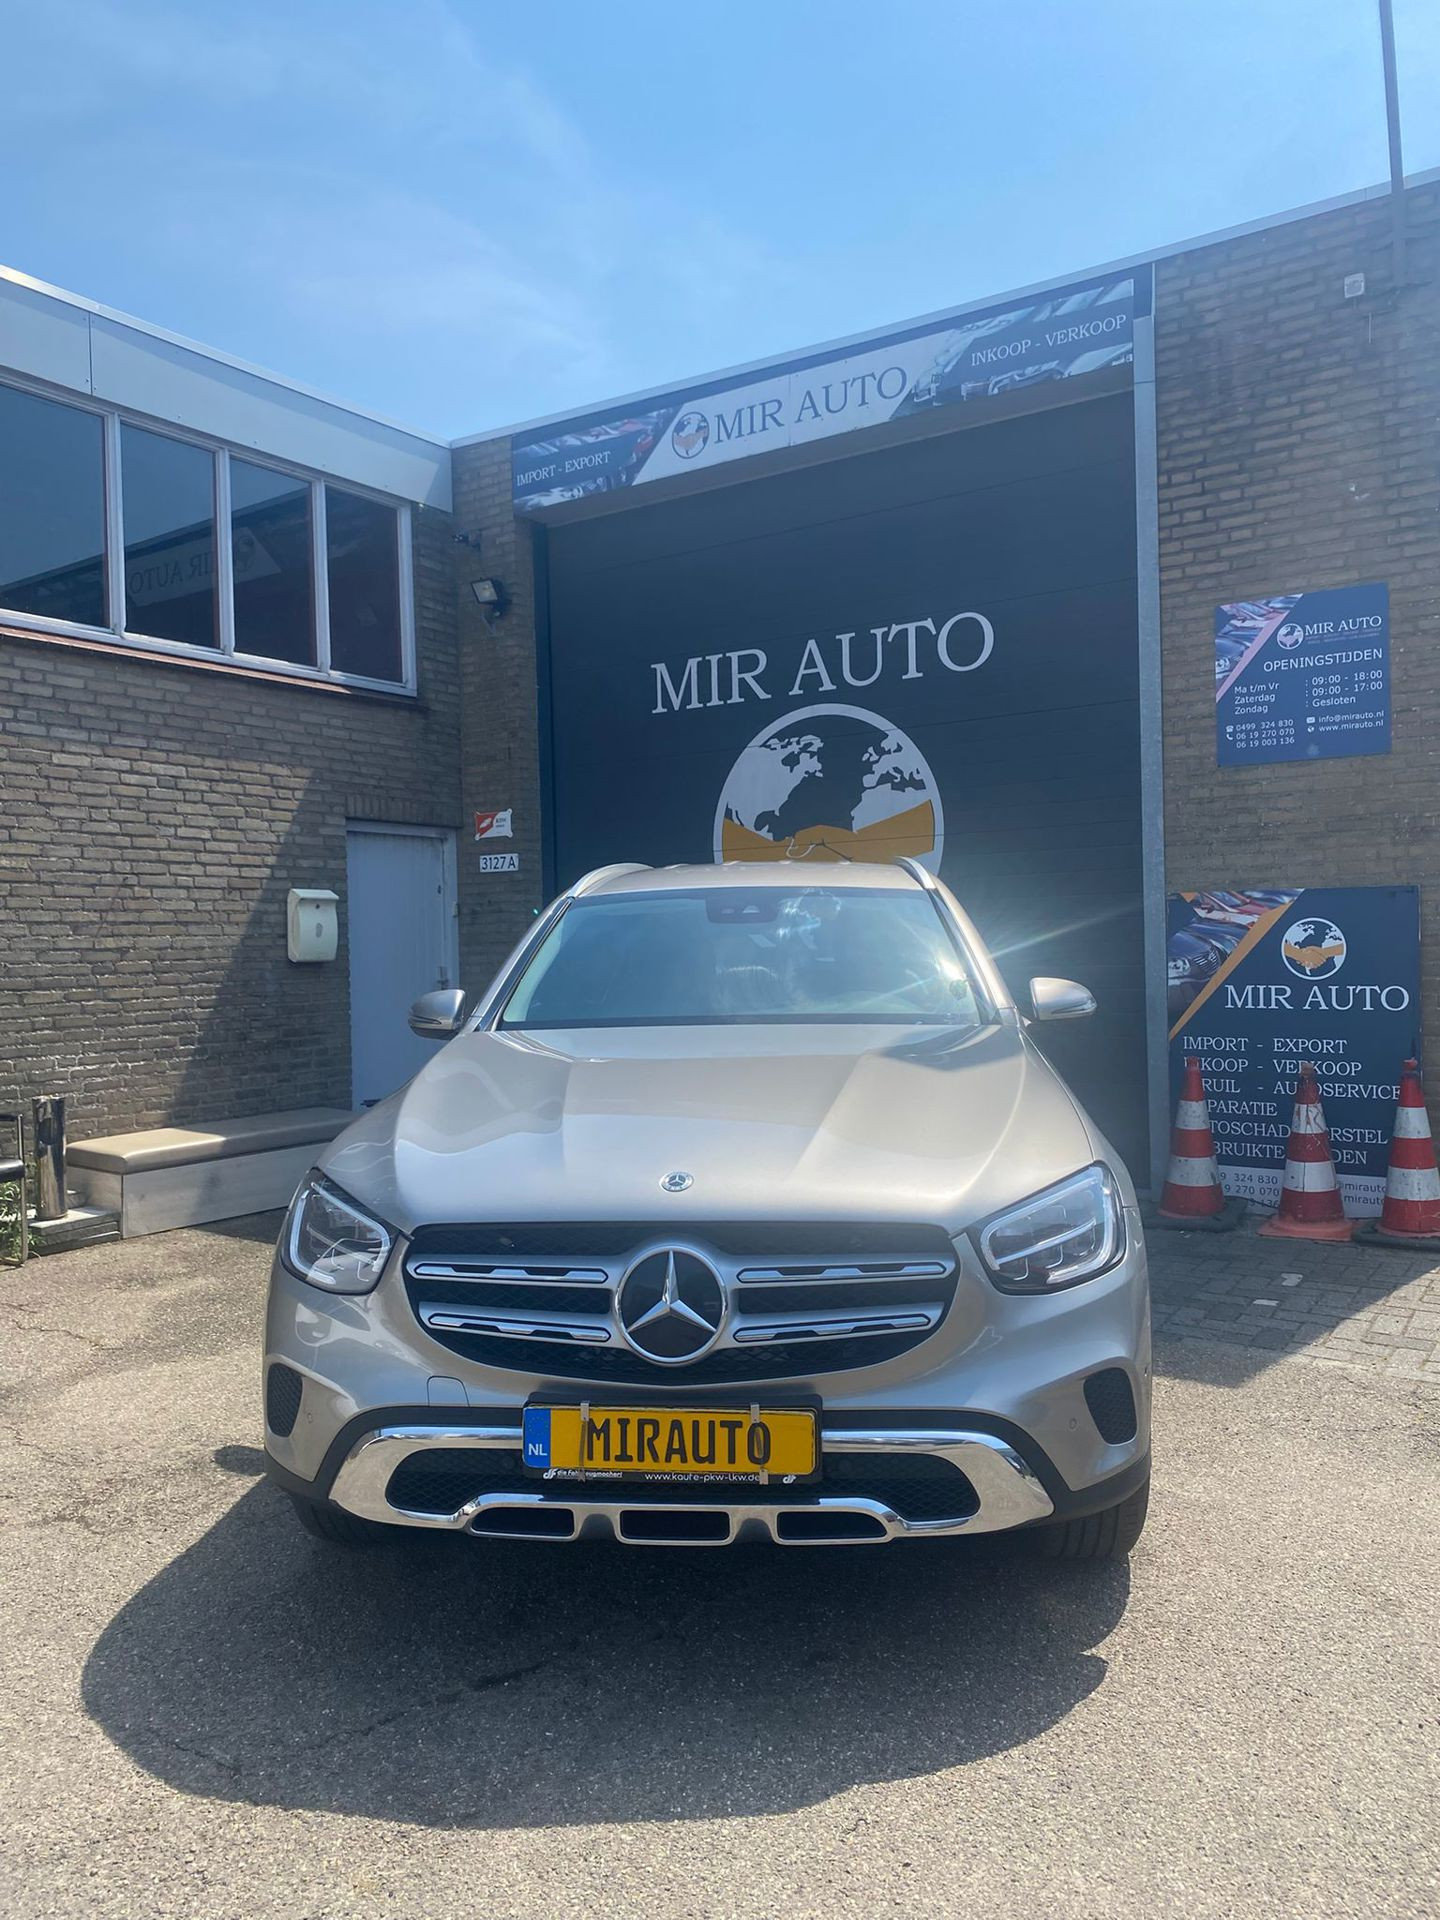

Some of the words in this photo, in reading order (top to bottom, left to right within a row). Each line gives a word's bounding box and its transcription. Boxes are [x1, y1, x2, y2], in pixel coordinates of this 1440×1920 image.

[971, 338, 1032, 367] INKOOP
[1044, 314, 1127, 348] VERKOOP
[713, 398, 785, 444] MIR
[794, 366, 908, 424] AUTO
[516, 463, 556, 487] IMPORT
[565, 450, 612, 474] EXPORT
[1305, 622, 1335, 636] MIR
[1338, 615, 1382, 632] AUTO
[651, 648, 772, 714] MIR
[789, 611, 995, 697] AUTO
[1263, 648, 1383, 673] OPENINGSTIJDEN
[1234, 686, 1247, 694] Ma
[1250, 684, 1266, 693] t/m
[1268, 682, 1280, 690] Vr
[1312, 674, 1341, 686] 09:00
[1354, 669, 1383, 681] 18:00
[1234, 694, 1275, 704] Zaterdag
[1312, 685, 1341, 696] 09:00
[1354, 681, 1383, 692] 17:00
[1234, 705, 1268, 715] Zondag
[1312, 696, 1356, 708] Gesloten
[1236, 722, 1256, 731] 0499
[1260, 721, 1275, 730] 324
[1278, 719, 1294, 728] 830
[1318, 710, 1385, 723] info@mirauto.nl
[1318, 720, 1384, 732] www.mirauto.nl
[1236, 732, 1247, 740] 06
[1249, 731, 1259, 739] 19
[1262, 729, 1277, 738] 270
[1279, 728, 1295, 736] 070
[1236, 741, 1247, 749] 06
[1250, 739, 1259, 747] 19
[1261, 738, 1277, 746] 003
[1280, 736, 1295, 745] 136
[1224, 984, 1294, 1009] MIR
[1303, 985, 1410, 1011] AUTO
[1183, 1036, 1249, 1052] IMPORT
[1273, 1038, 1348, 1054] EXPORT
[1201, 1078, 1241, 1093] RUIL
[1207, 1099, 1278, 1116] PARATIE
[528, 1443, 548, 1456] NL
[586, 1417, 771, 1466] MIRAUTO
